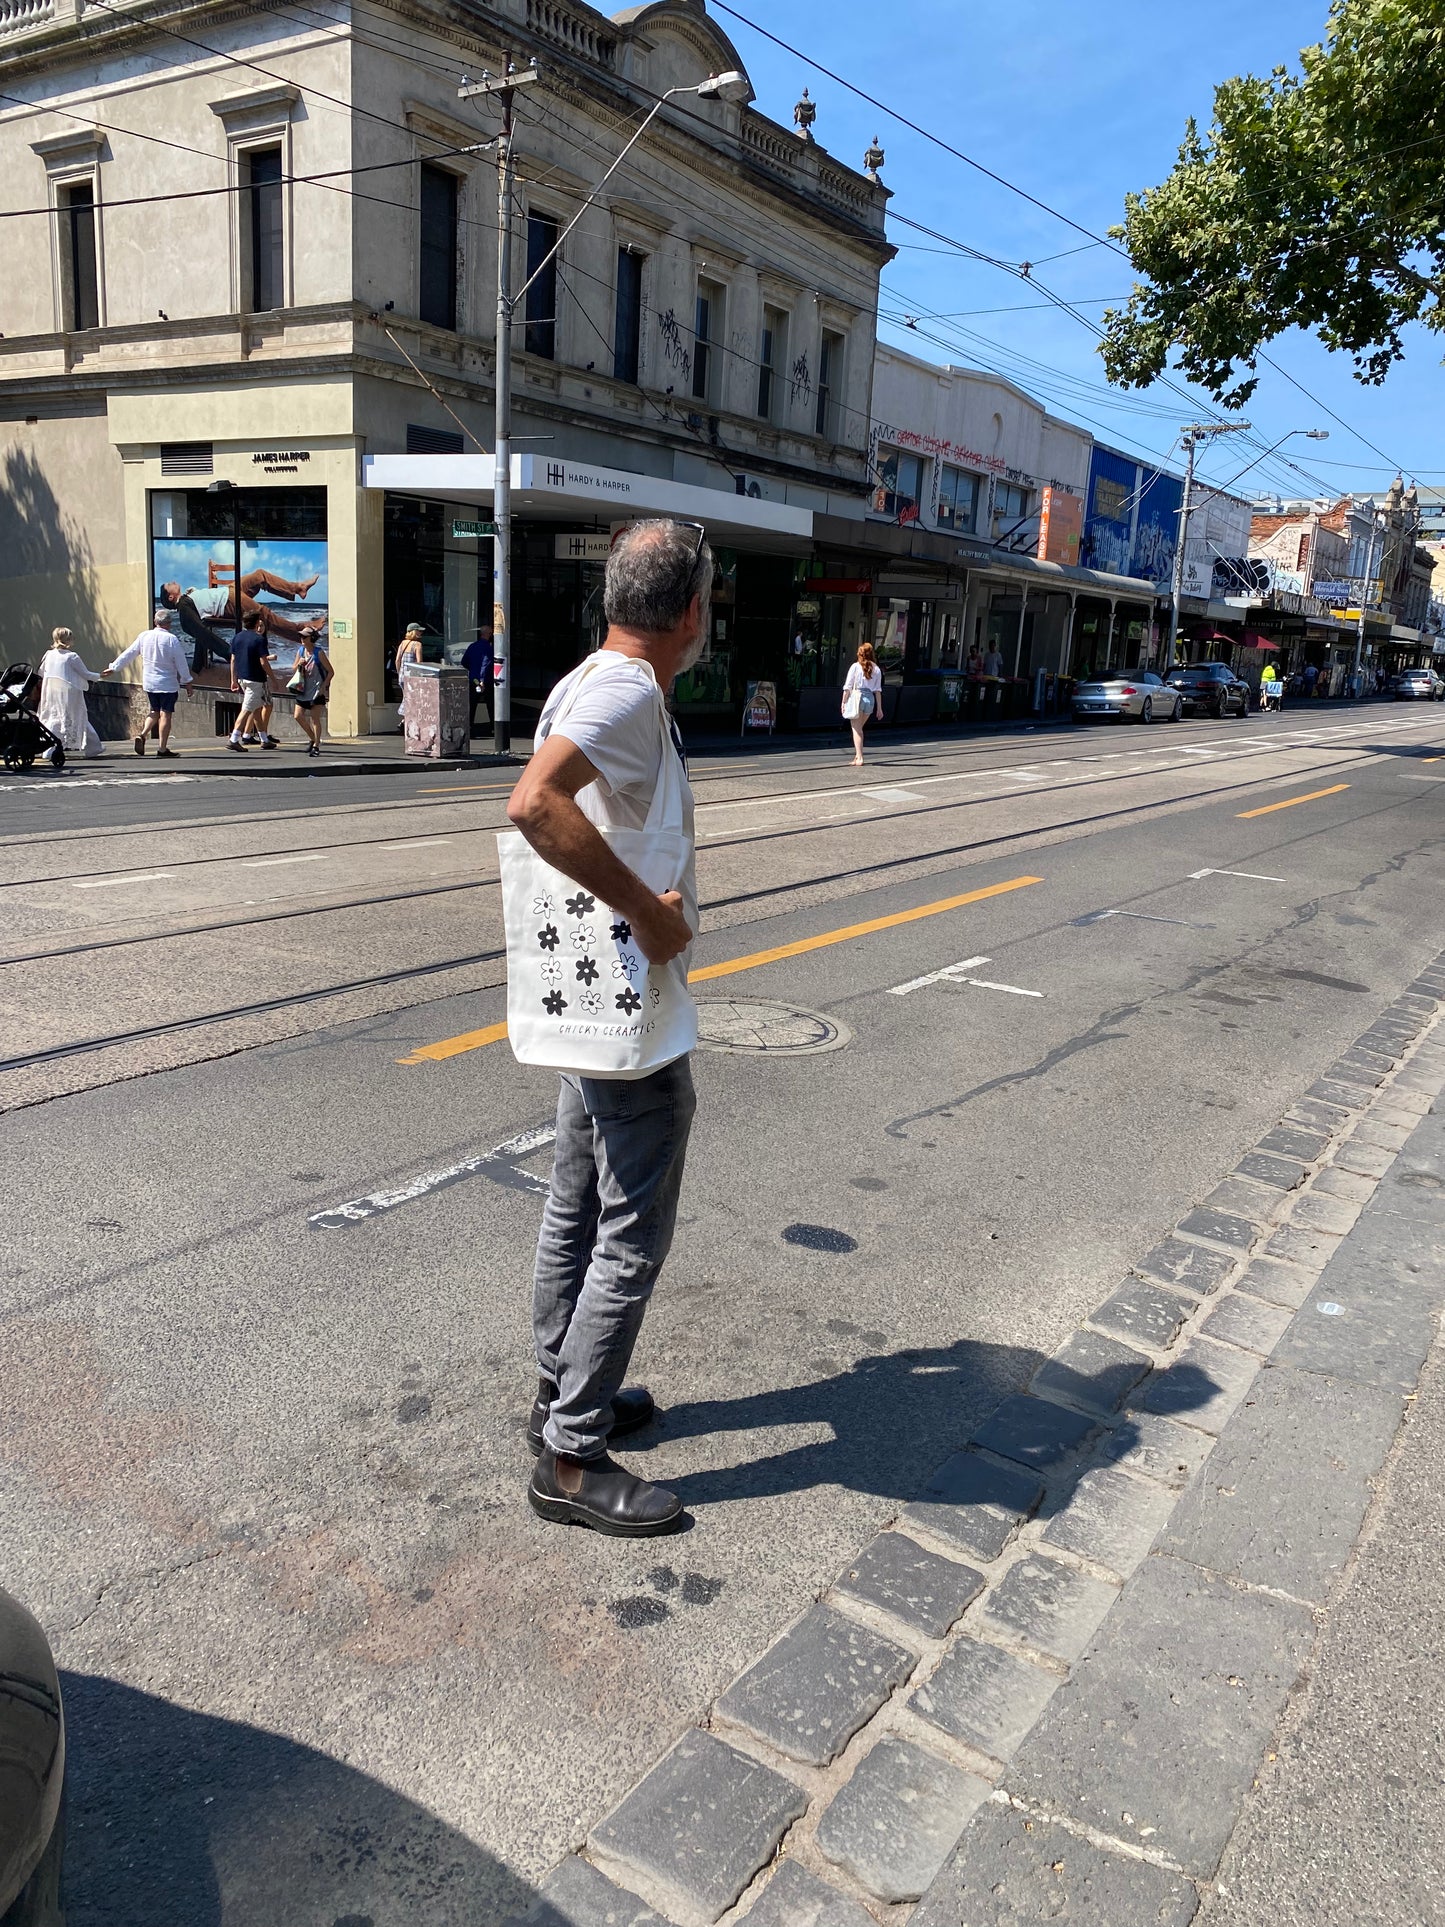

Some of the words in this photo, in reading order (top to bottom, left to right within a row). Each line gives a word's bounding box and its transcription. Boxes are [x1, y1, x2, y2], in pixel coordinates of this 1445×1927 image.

[252, 453, 278, 464] JAMES
[279, 452, 310, 462] HARPER
[568, 473, 594, 485] HARDY
[596, 478, 600, 487] &
[602, 480, 631, 492] HARPER
[1042, 490, 1051, 514] FOR
[456, 521, 476, 532] SMITH
[477, 523, 485, 532] ST
[1039, 518, 1048, 558] LEASE
[588, 543, 611, 551] HARD
[1337, 586, 1349, 594] Sun
[751, 707, 767, 715] TAKE
[559, 1024, 599, 1037] CHICKY
[603, 1020, 656, 1037] CERAMICS
